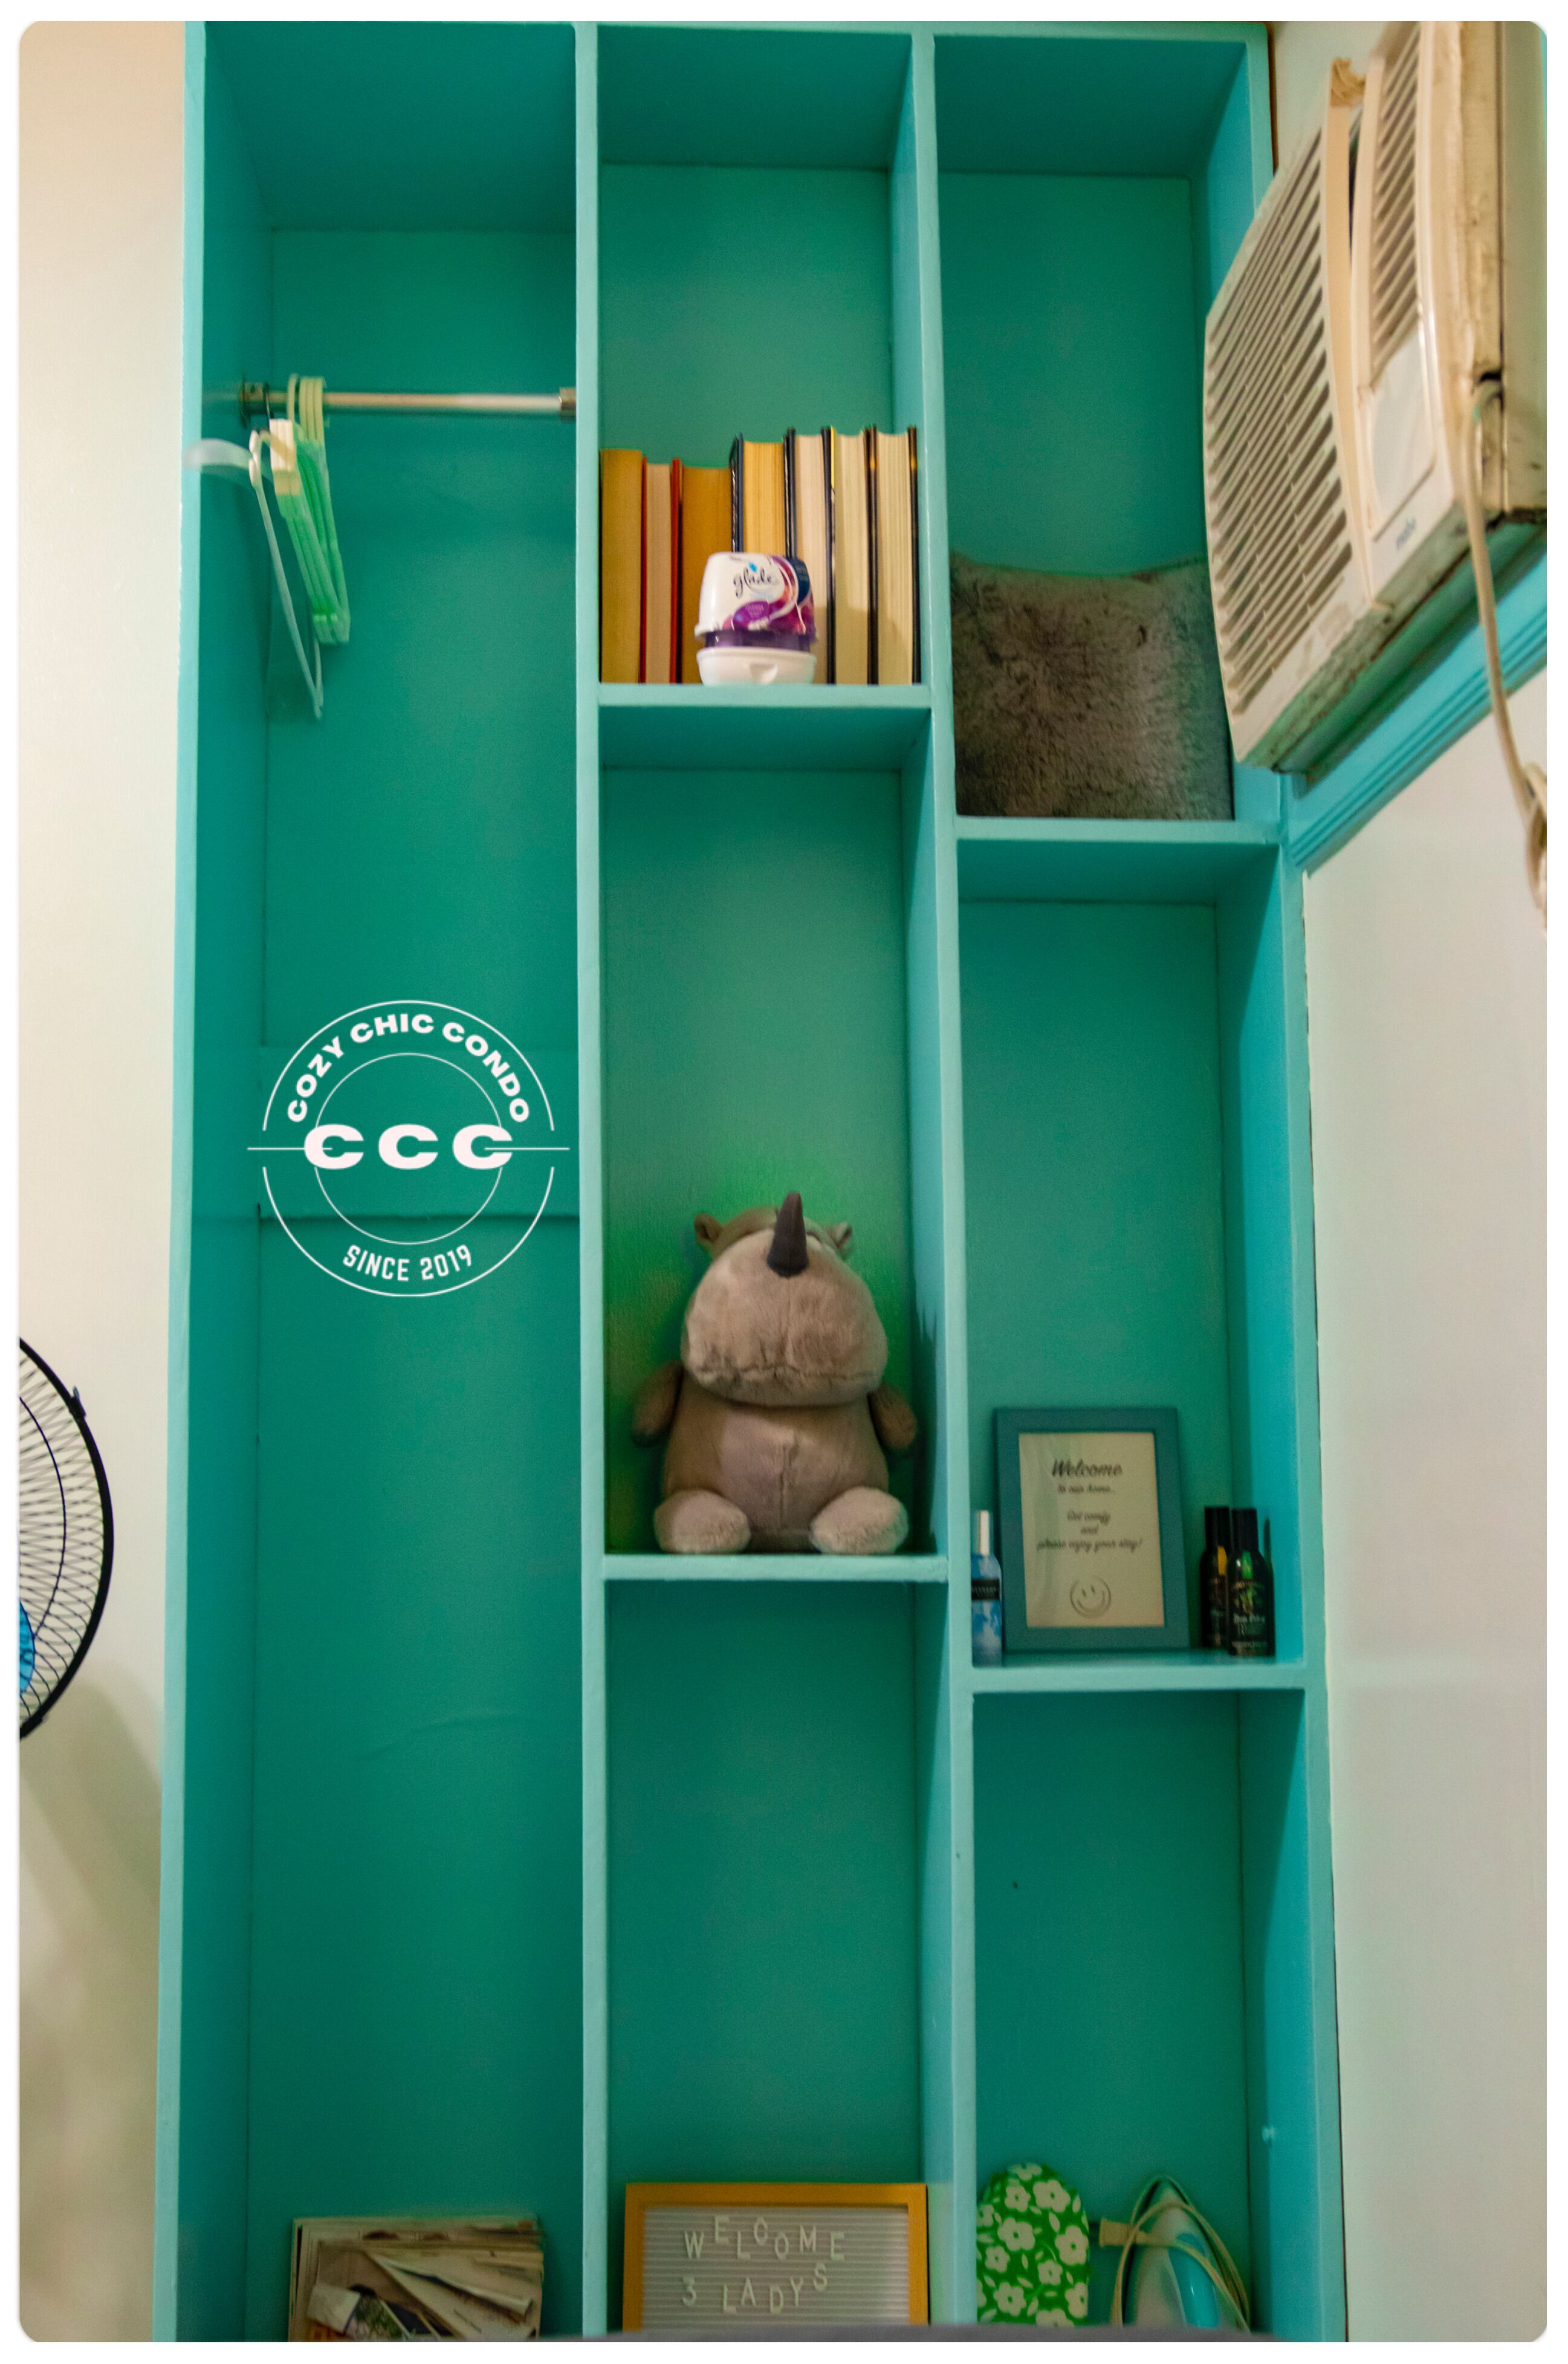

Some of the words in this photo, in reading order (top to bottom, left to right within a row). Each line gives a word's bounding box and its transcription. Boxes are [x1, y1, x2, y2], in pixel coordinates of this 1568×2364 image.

[1052, 1459, 1123, 1477] Welcome
[684, 2215, 846, 2262] WELCOME
[682, 2276, 698, 2307] 3
[722, 2262, 828, 2314] LADYS
